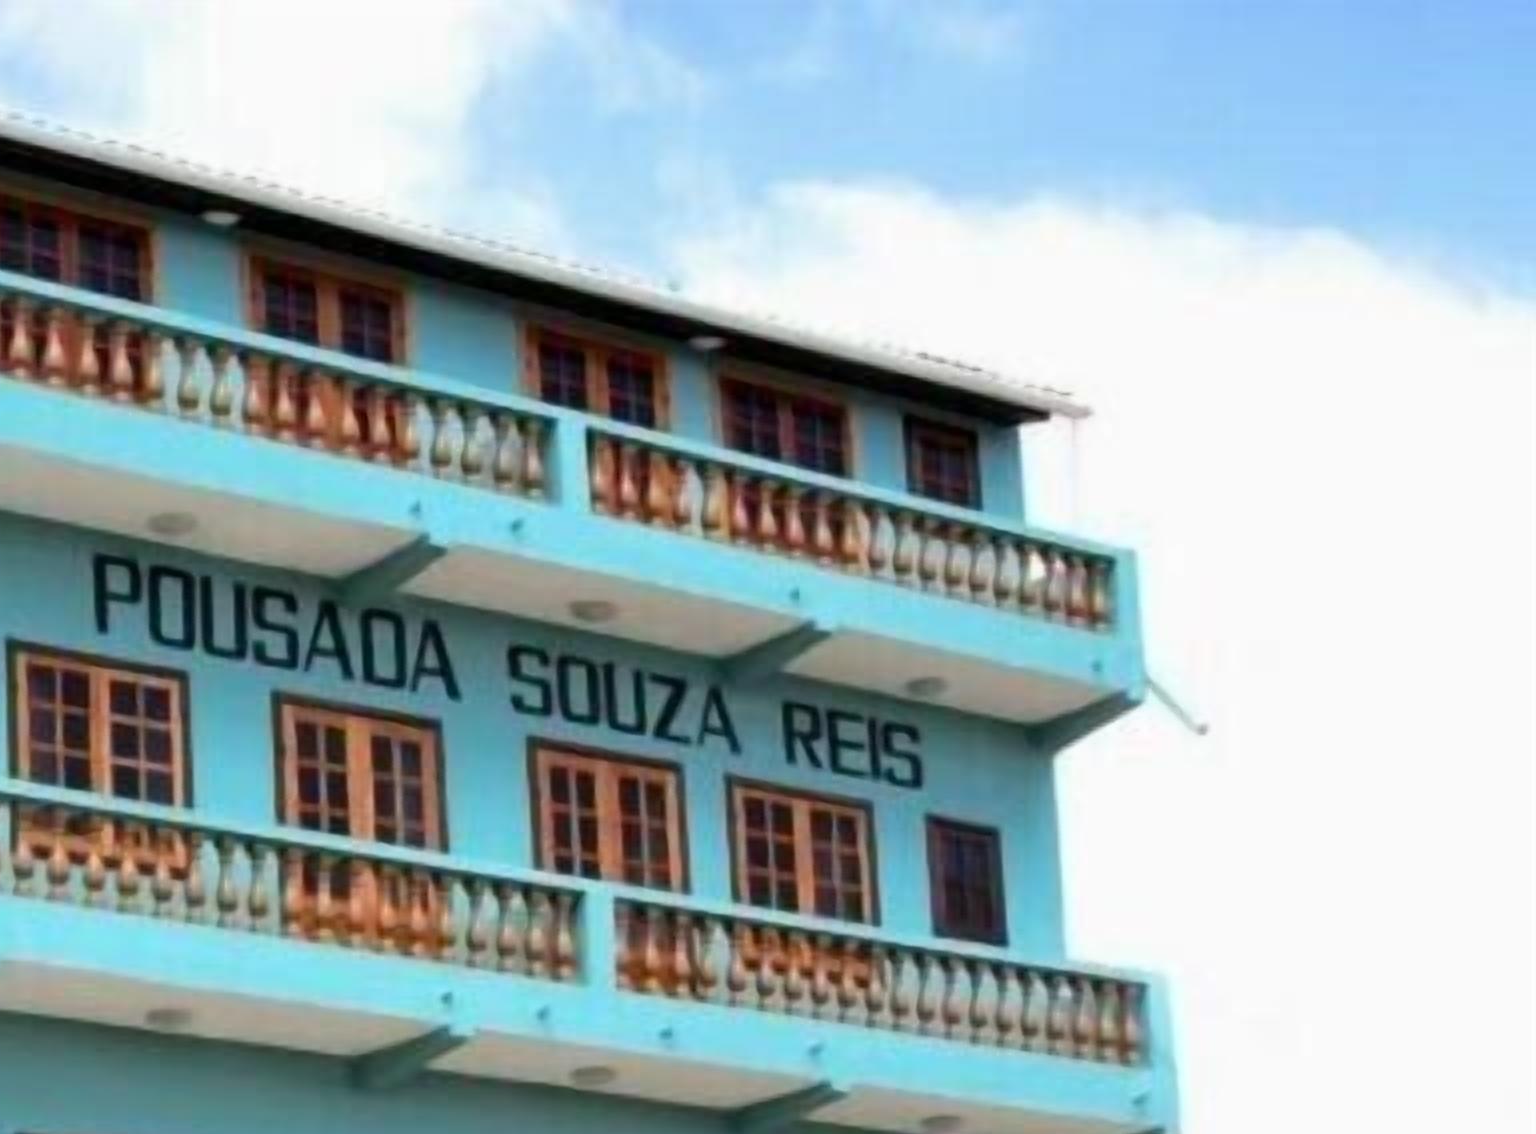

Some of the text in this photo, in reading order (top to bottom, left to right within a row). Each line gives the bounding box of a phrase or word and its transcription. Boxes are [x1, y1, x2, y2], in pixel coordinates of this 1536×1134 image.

[92, 553, 924, 790] POUSADA SOUZA REIS
